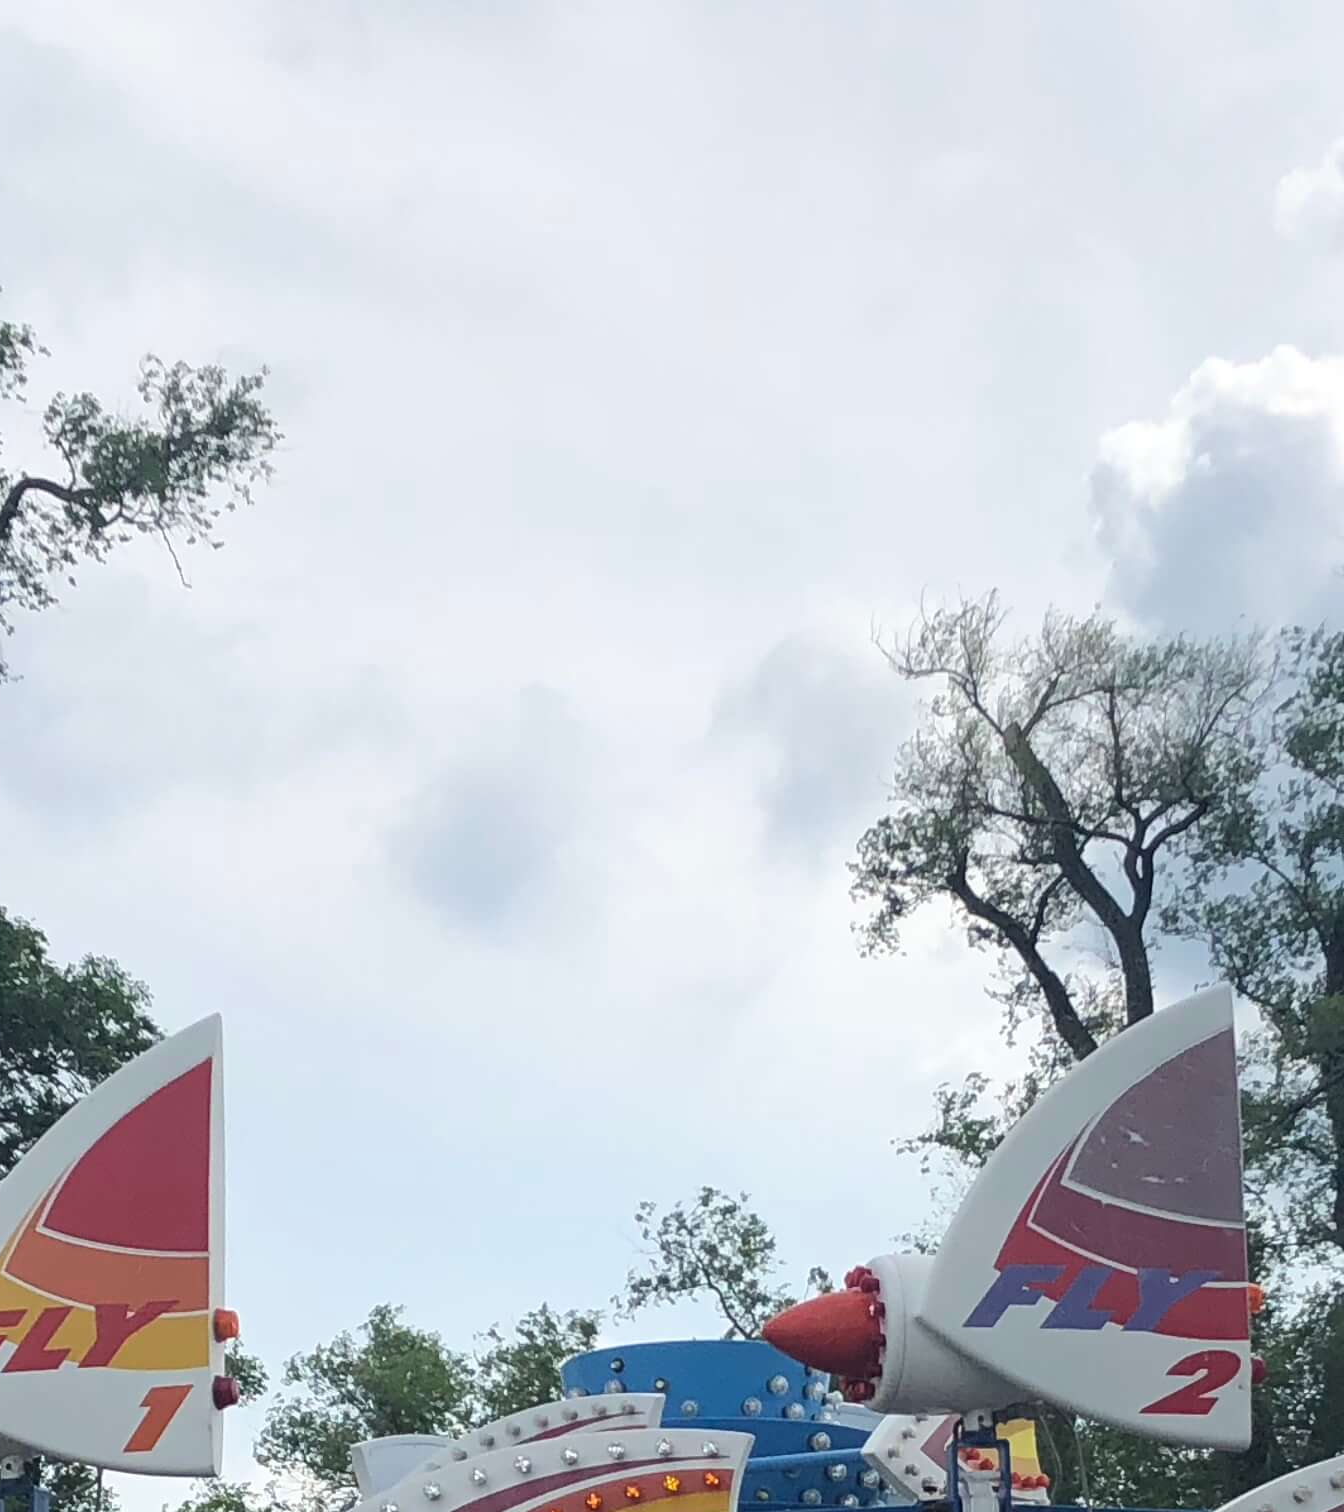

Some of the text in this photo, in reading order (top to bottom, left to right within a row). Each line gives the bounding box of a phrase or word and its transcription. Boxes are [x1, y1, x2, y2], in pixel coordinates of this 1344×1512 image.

[962, 1263, 1220, 1331] FLY
[1139, 1350, 1242, 1415] 2
[123, 1384, 194, 1453] 1
